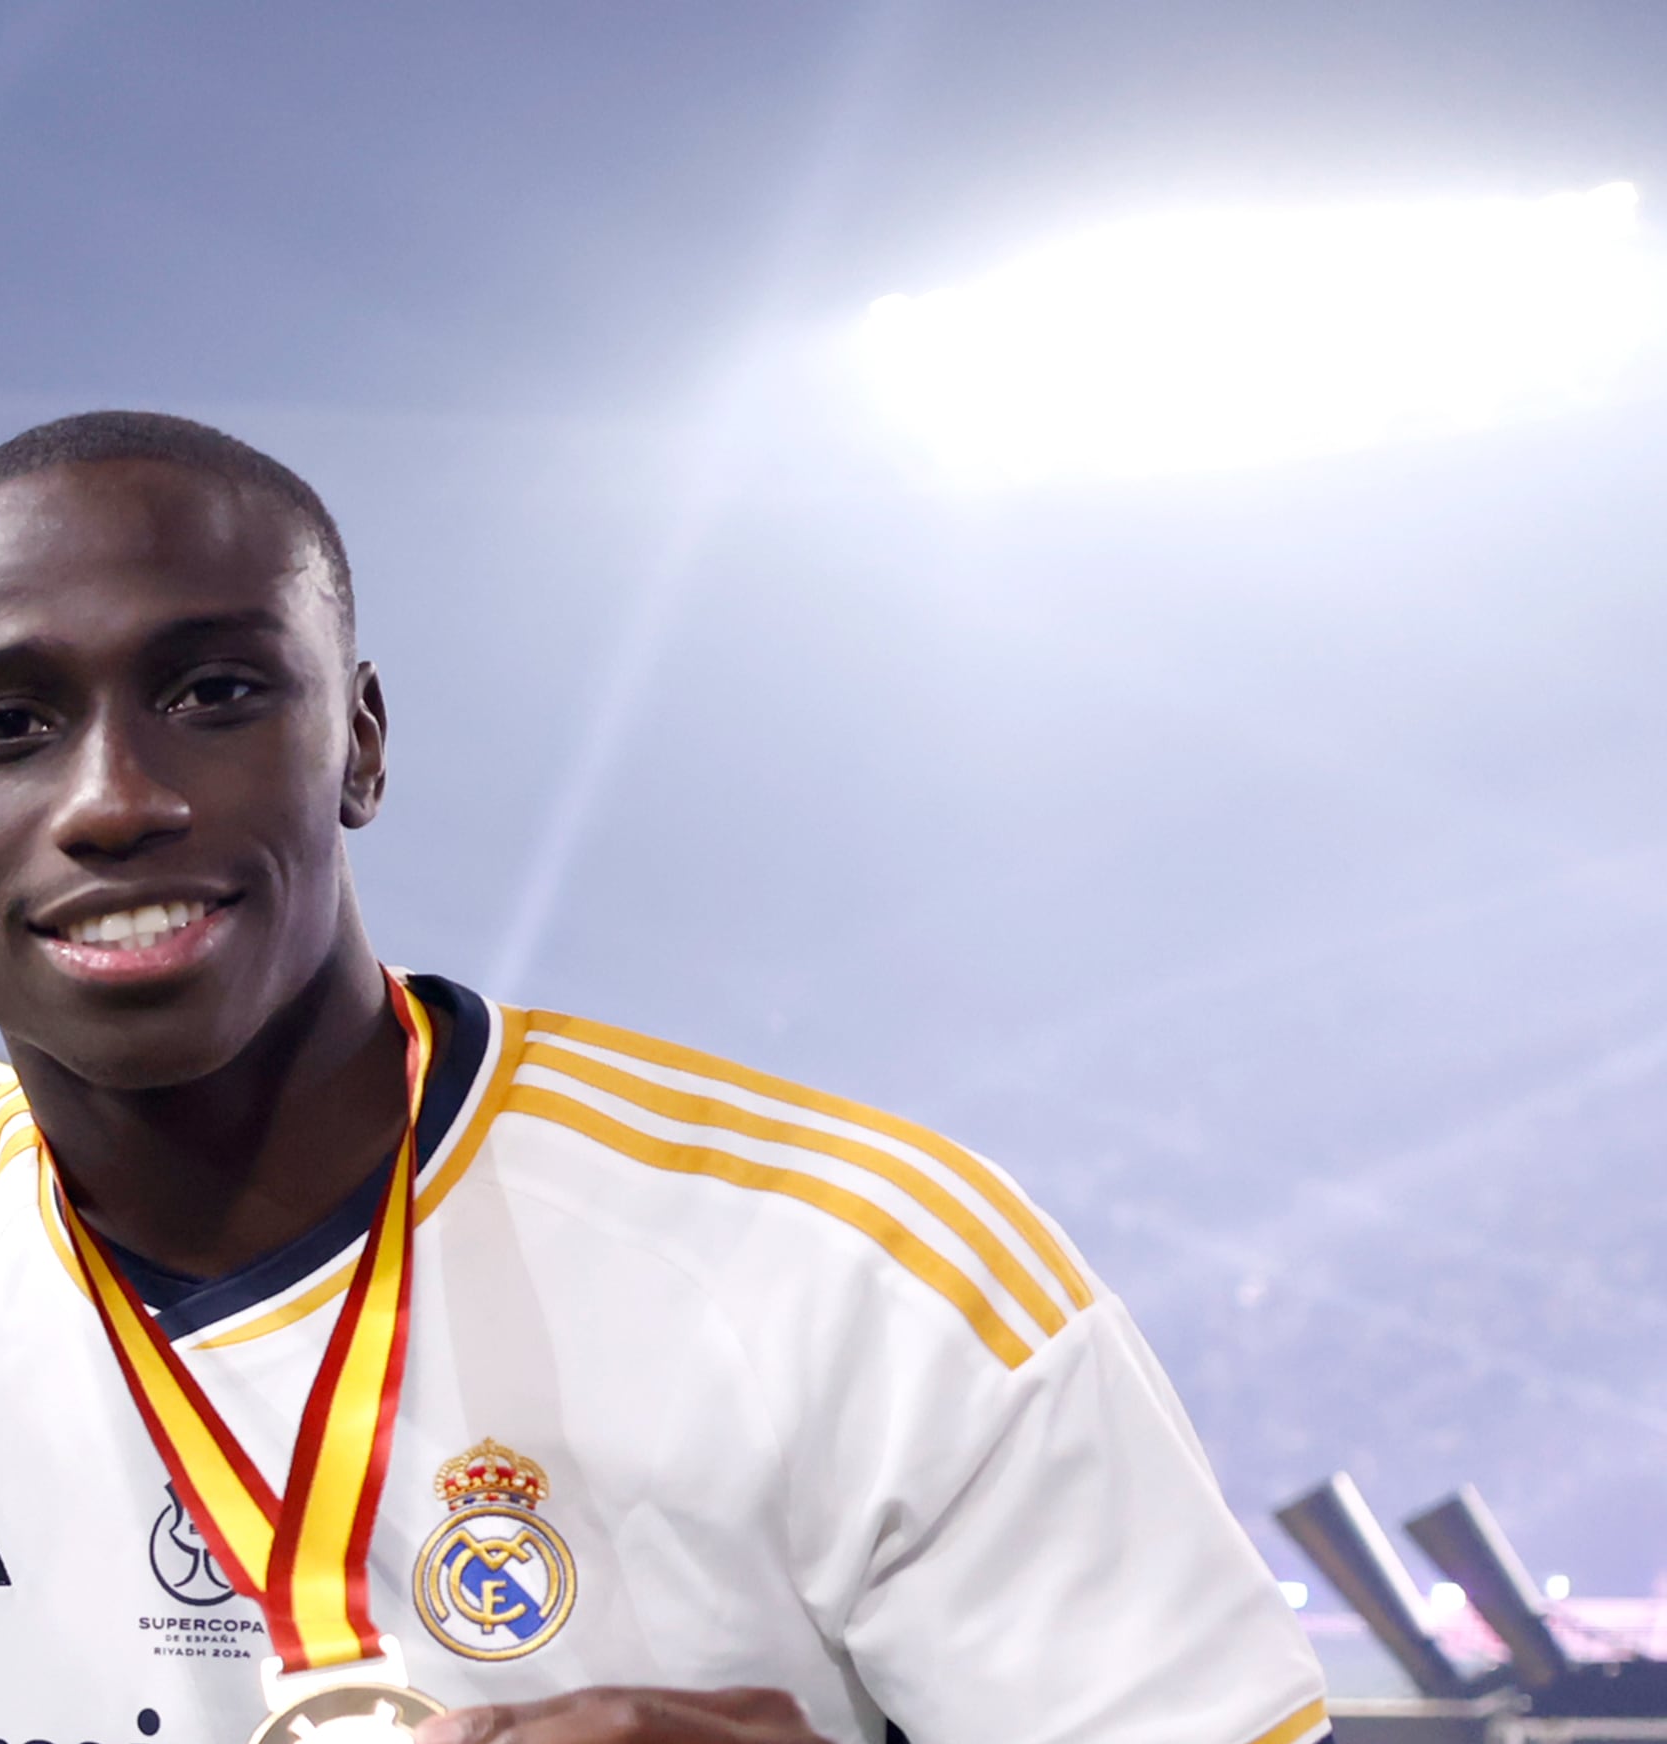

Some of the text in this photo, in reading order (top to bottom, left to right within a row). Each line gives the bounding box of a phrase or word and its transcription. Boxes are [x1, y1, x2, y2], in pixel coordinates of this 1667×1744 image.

[138, 1616, 266, 1635] SUPERCOPA
[165, 1631, 238, 1645] DE ESPAÑA
[153, 1646, 252, 1660] RIYADH 2024
